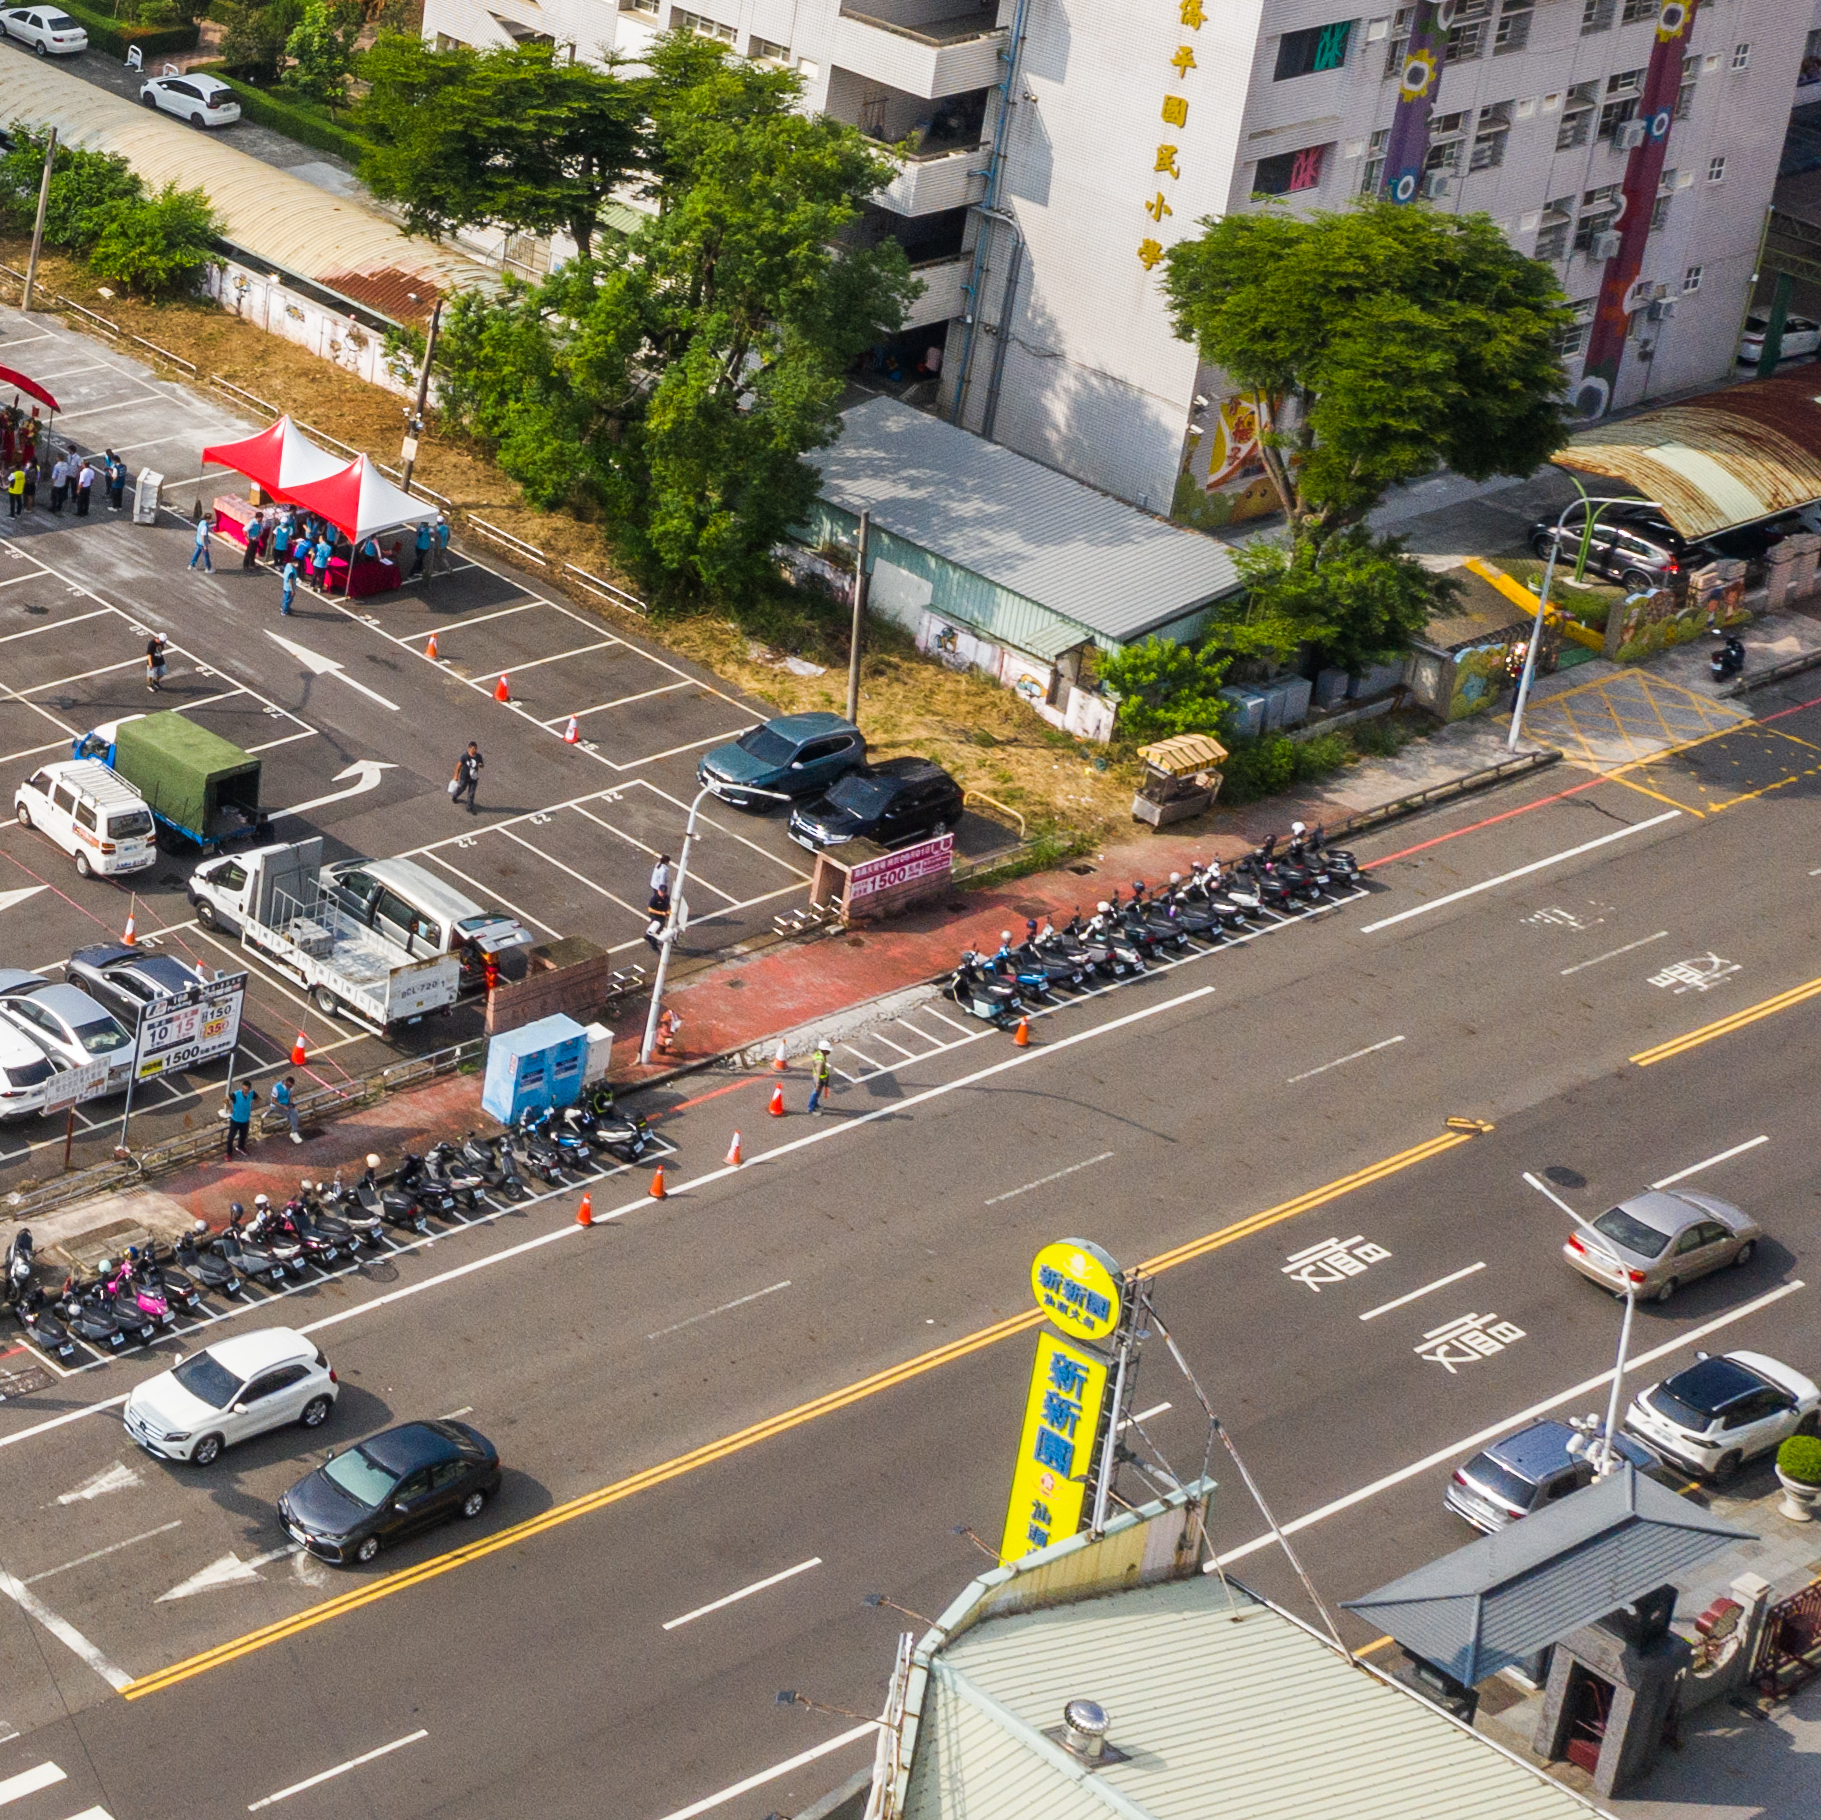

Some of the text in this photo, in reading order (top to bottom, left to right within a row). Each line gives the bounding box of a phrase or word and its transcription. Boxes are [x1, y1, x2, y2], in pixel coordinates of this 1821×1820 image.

[869, 867, 907, 892] 1500
[149, 1026, 169, 1043] 10
[175, 1018, 195, 1036] 15
[165, 1046, 200, 1067] 1500
[1281, 1235, 1393, 1293] 慢
[1038, 1263, 1110, 1324] 新新園
[1412, 1312, 1528, 1375] 慢
[1033, 1351, 1089, 1482] 新新園
[1025, 1498, 1053, 1557] 汕頭
